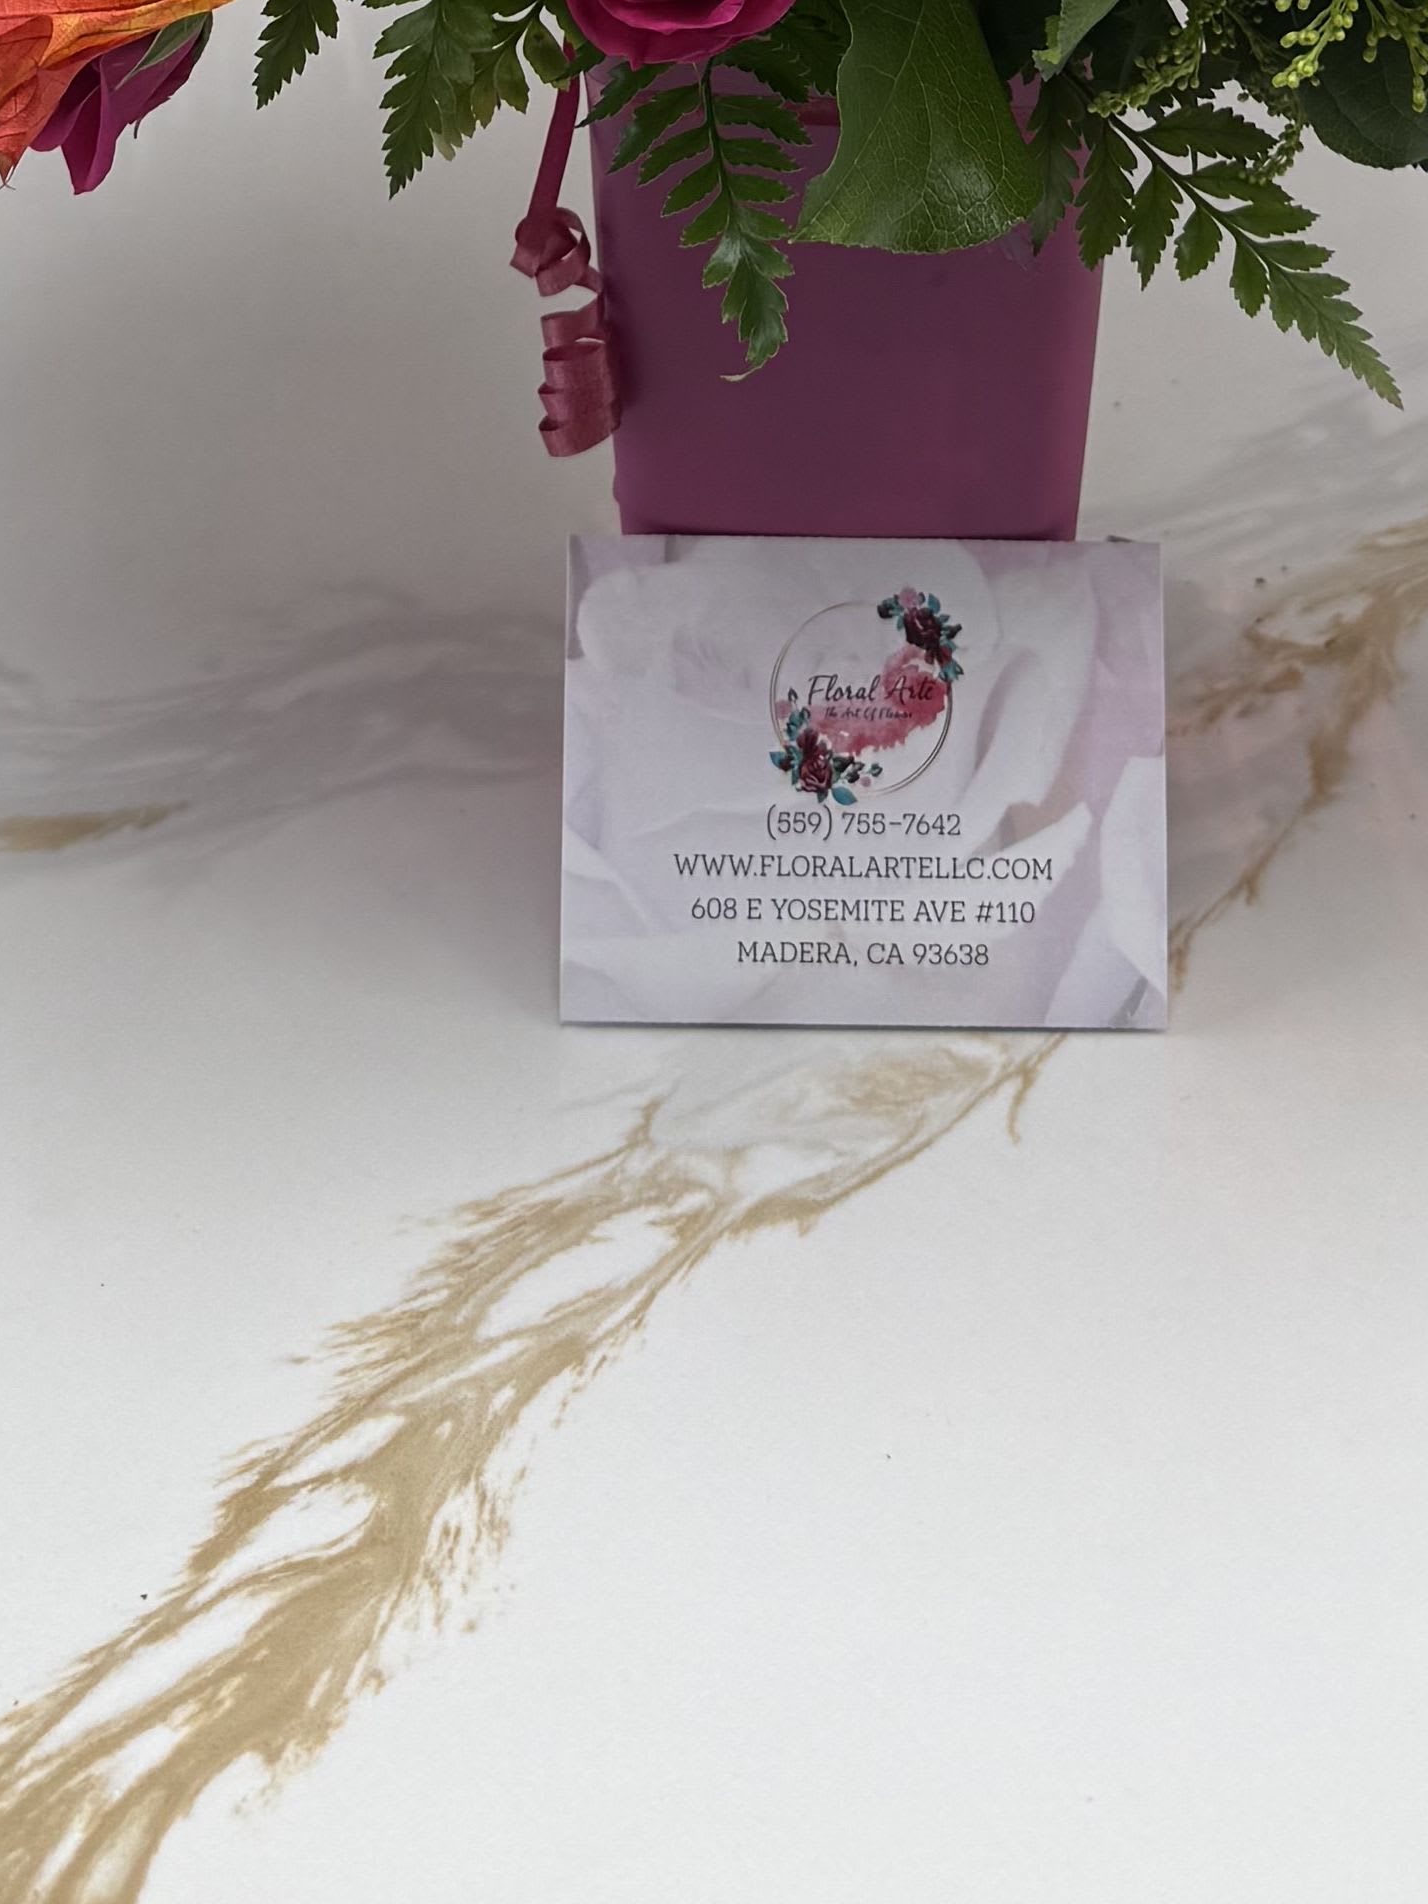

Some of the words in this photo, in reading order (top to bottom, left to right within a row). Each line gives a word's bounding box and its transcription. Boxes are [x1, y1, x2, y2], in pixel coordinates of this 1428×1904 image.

[808, 673, 881, 705] Floral
[884, 675, 936, 705] Arte
[766, 803, 834, 842] (559)
[841, 811, 962, 838] 755-7642
[673, 852, 1054, 882] WWW.FLORALARTELLC.COM
[690, 896, 739, 921] 608
[746, 897, 762, 921] E
[770, 897, 905, 923] YOSEMITE
[912, 899, 966, 924] AVE
[975, 900, 1036, 925] #110
[736, 940, 859, 968] MADERA,
[866, 942, 905, 967] CA
[912, 942, 990, 967] 93638
